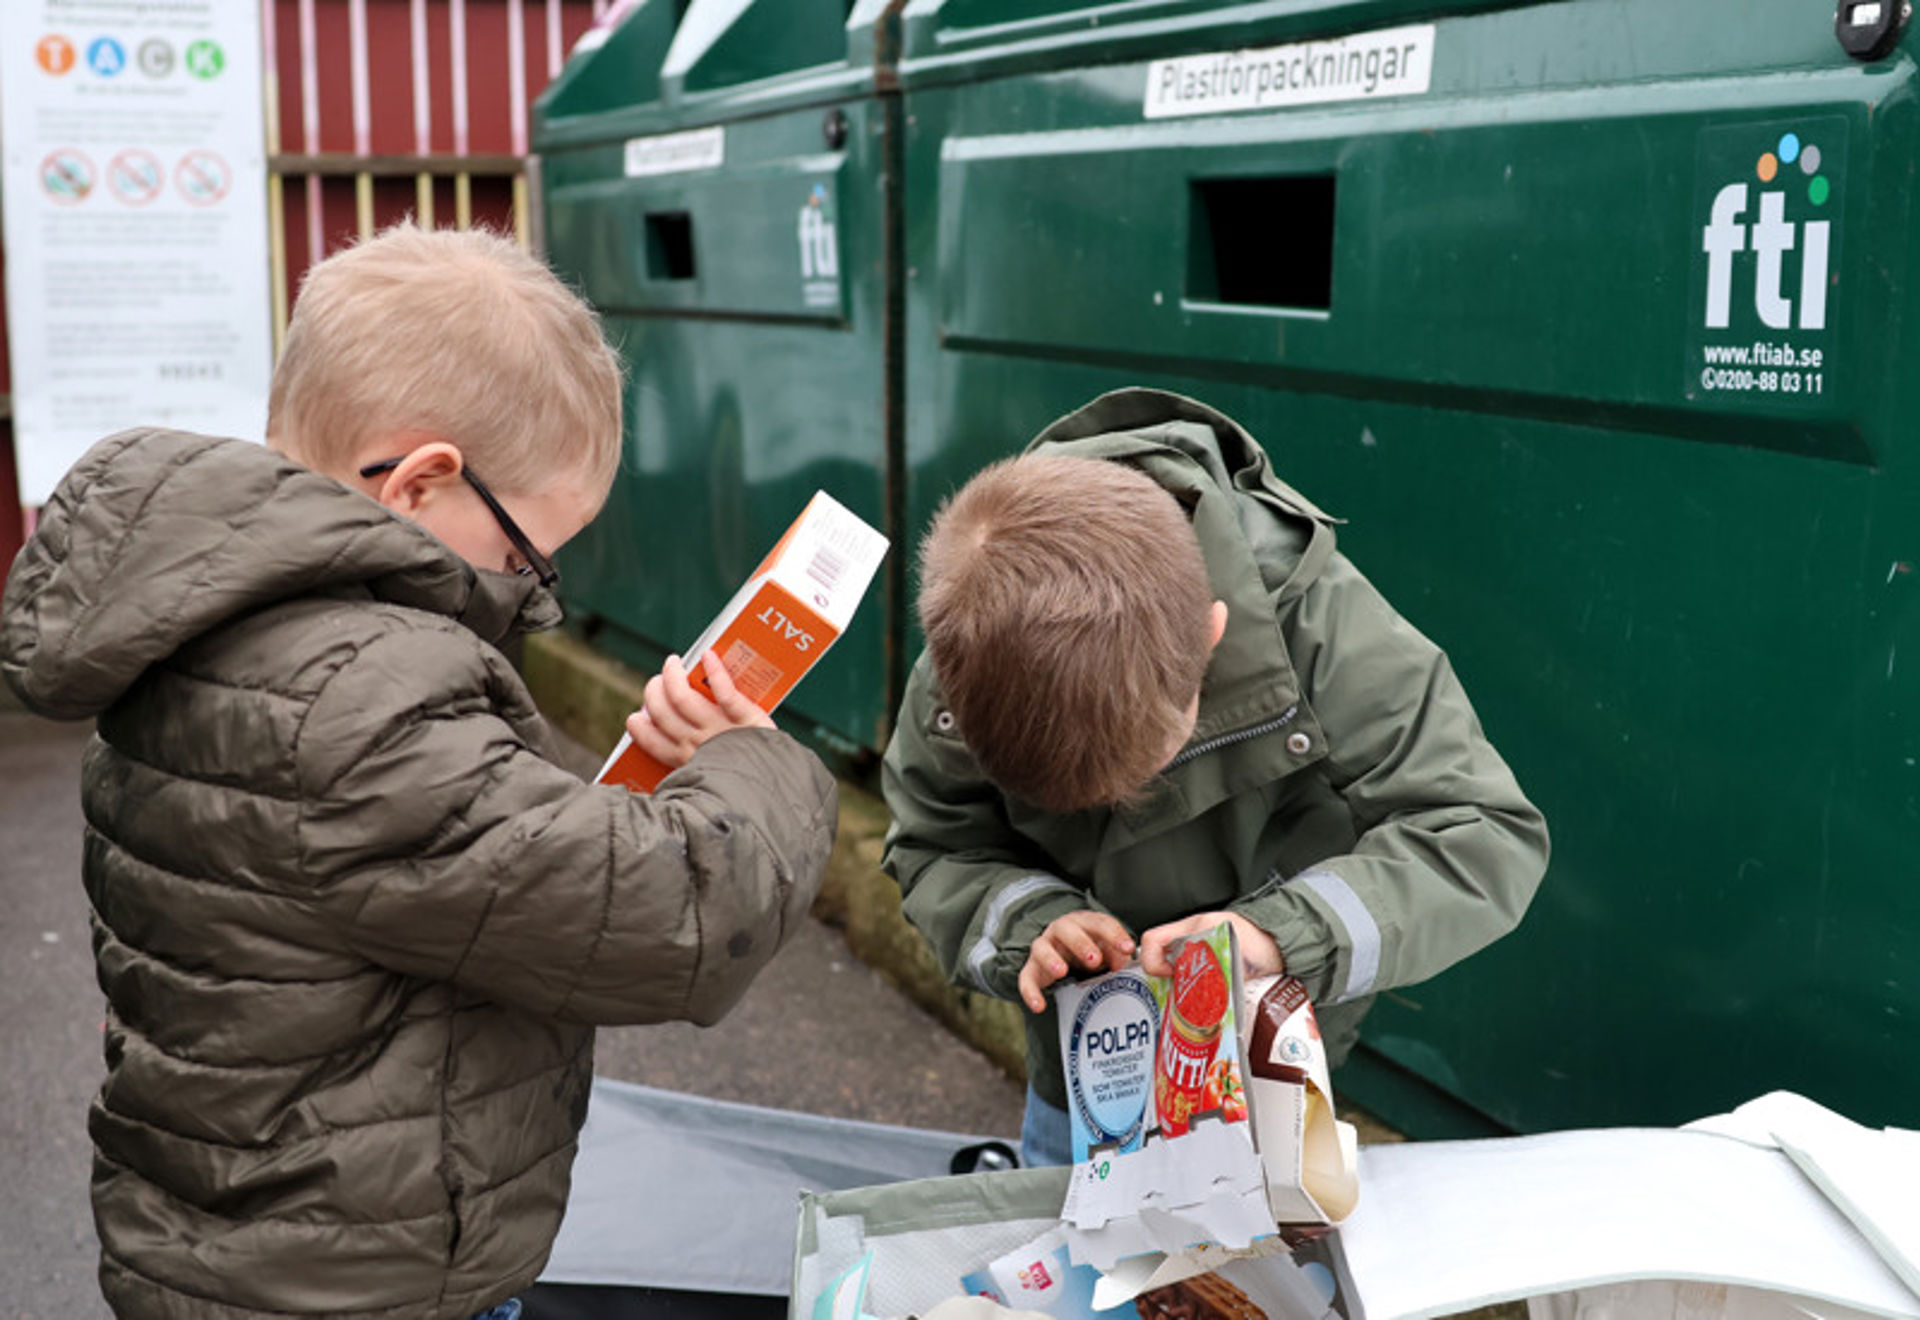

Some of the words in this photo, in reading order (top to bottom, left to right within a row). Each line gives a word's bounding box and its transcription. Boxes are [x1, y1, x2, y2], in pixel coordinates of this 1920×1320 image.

[1158, 42, 1416, 103] Plastförpackningar
[1702, 182, 1830, 329] fti
[1704, 341, 1823, 367] www.ftiab.se
[1781, 372, 1801, 392] 03
[1805, 374, 1823, 394] 11
[757, 606, 815, 651] SALT
[1087, 1019, 1150, 1058] POLPA
